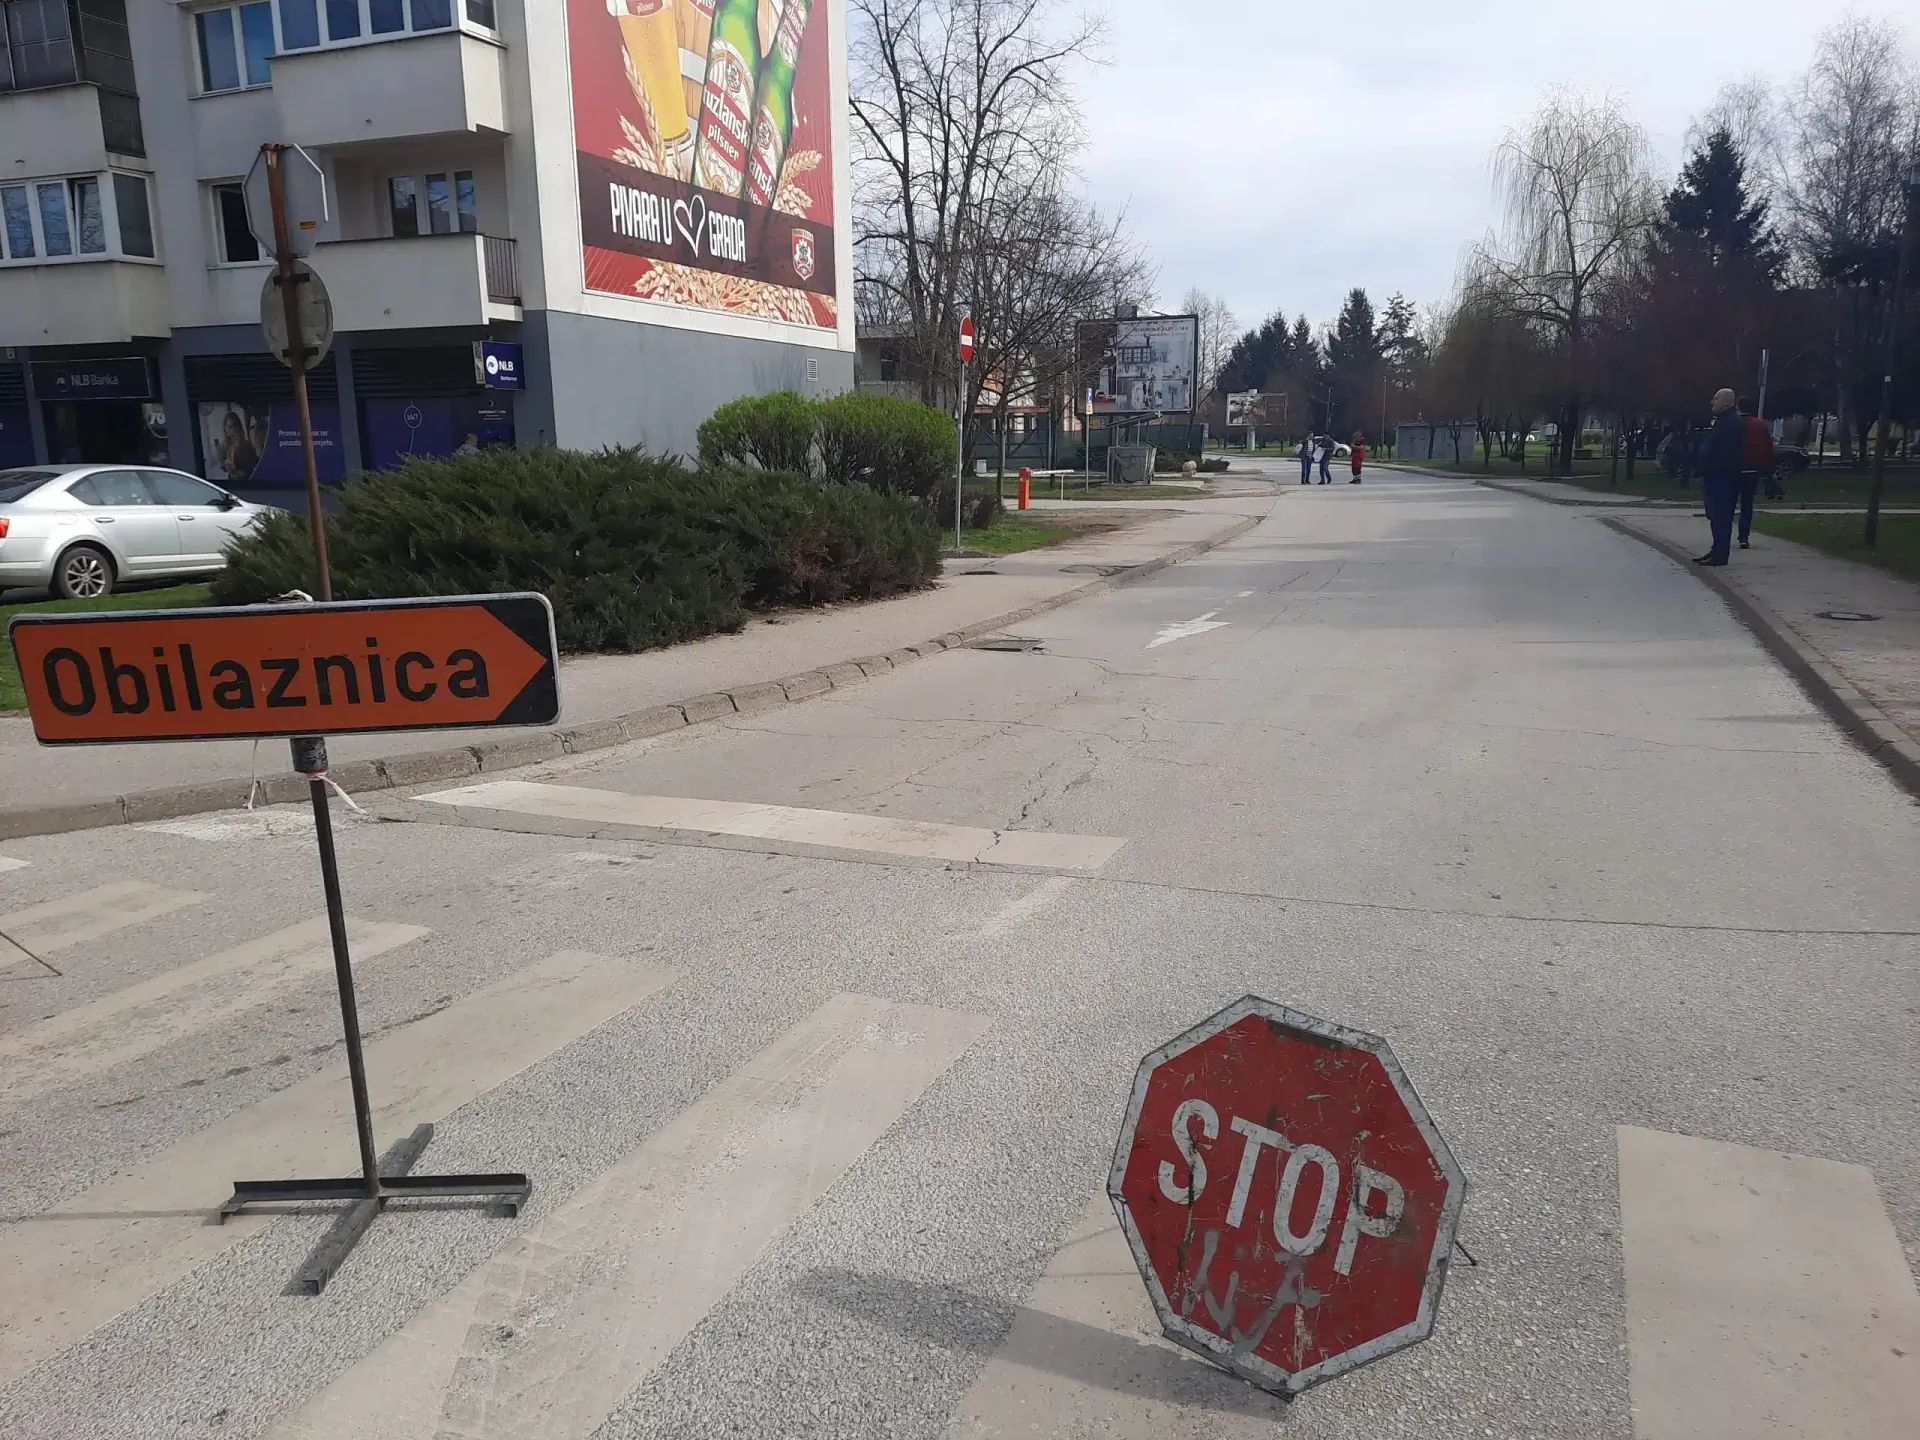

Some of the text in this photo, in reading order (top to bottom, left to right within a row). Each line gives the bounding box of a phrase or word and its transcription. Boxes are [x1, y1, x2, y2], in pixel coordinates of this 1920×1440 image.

[707, 124, 739, 160] pilsner
[609, 182, 746, 264] PIVARA U GRADA
[71, 373, 119, 387] NLB Banka
[498, 360, 514, 372] NLB
[42, 637, 491, 717] Obilaznica
[1157, 1098, 1406, 1277] STOP
